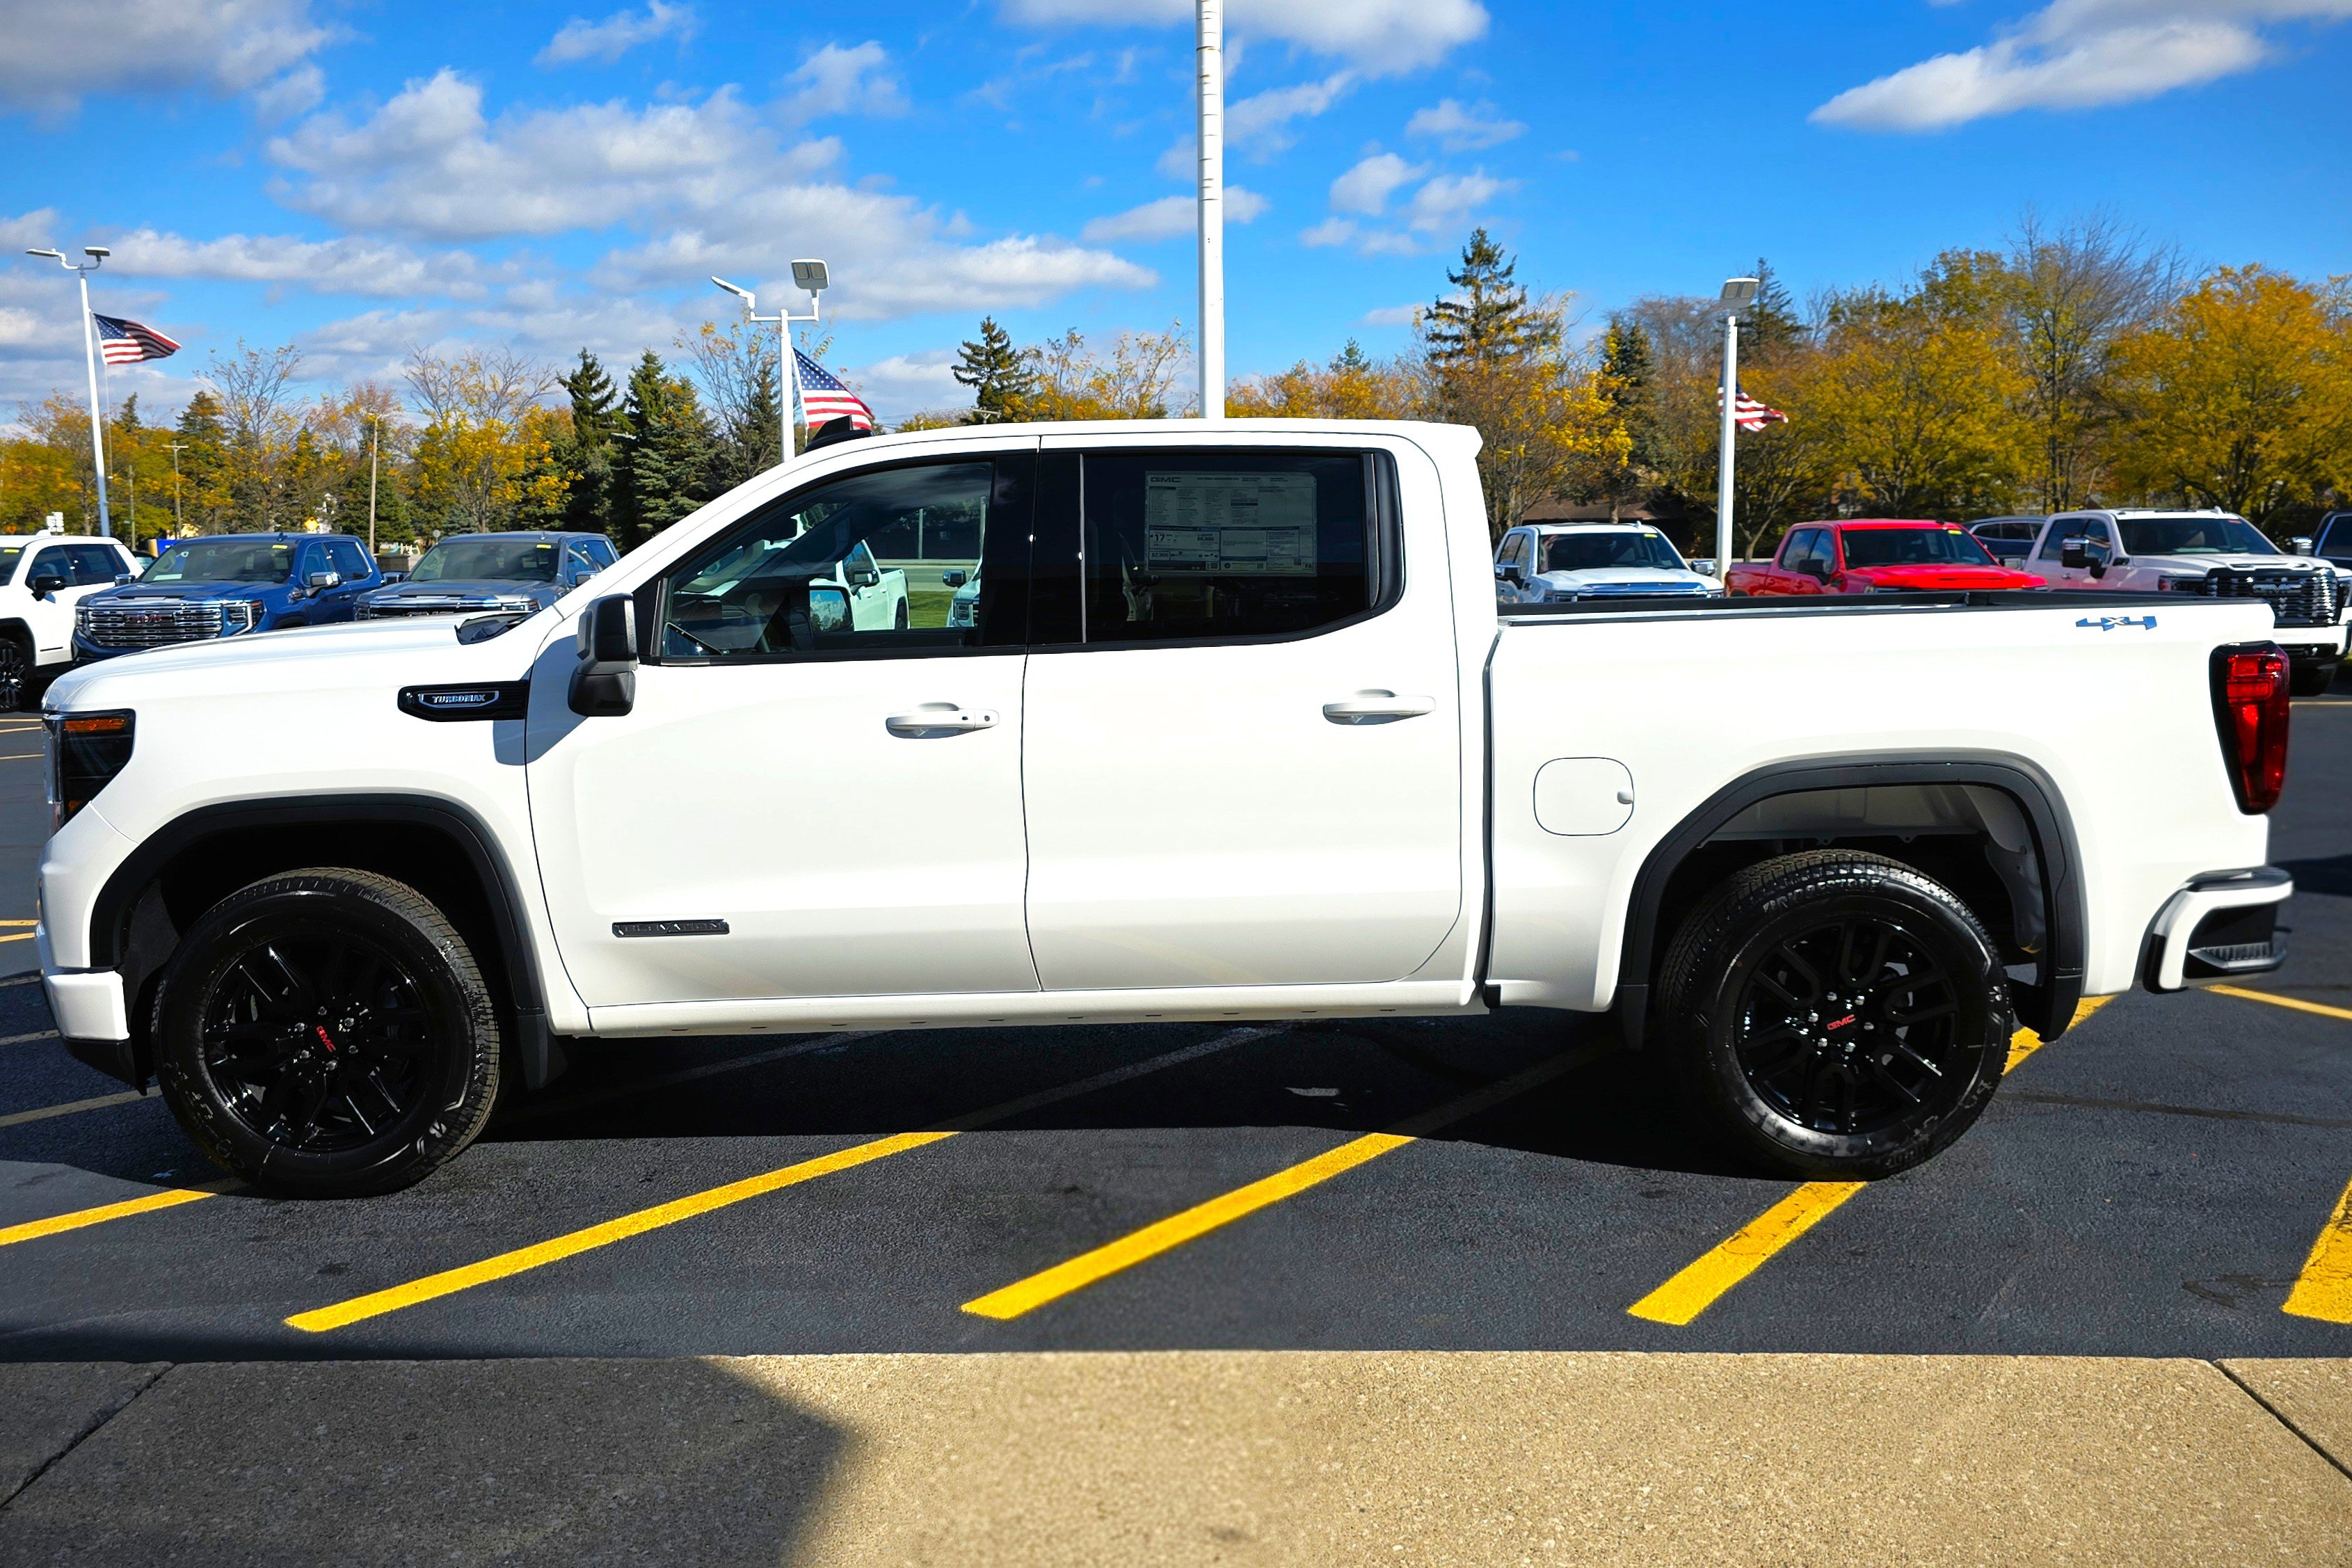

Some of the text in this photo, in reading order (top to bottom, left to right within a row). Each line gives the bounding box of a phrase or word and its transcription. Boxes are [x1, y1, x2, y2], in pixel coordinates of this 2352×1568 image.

[432, 694, 486, 704] TURBOMAX
[1827, 1014, 1857, 1030] GMC
[316, 1025, 337, 1053] GMC
